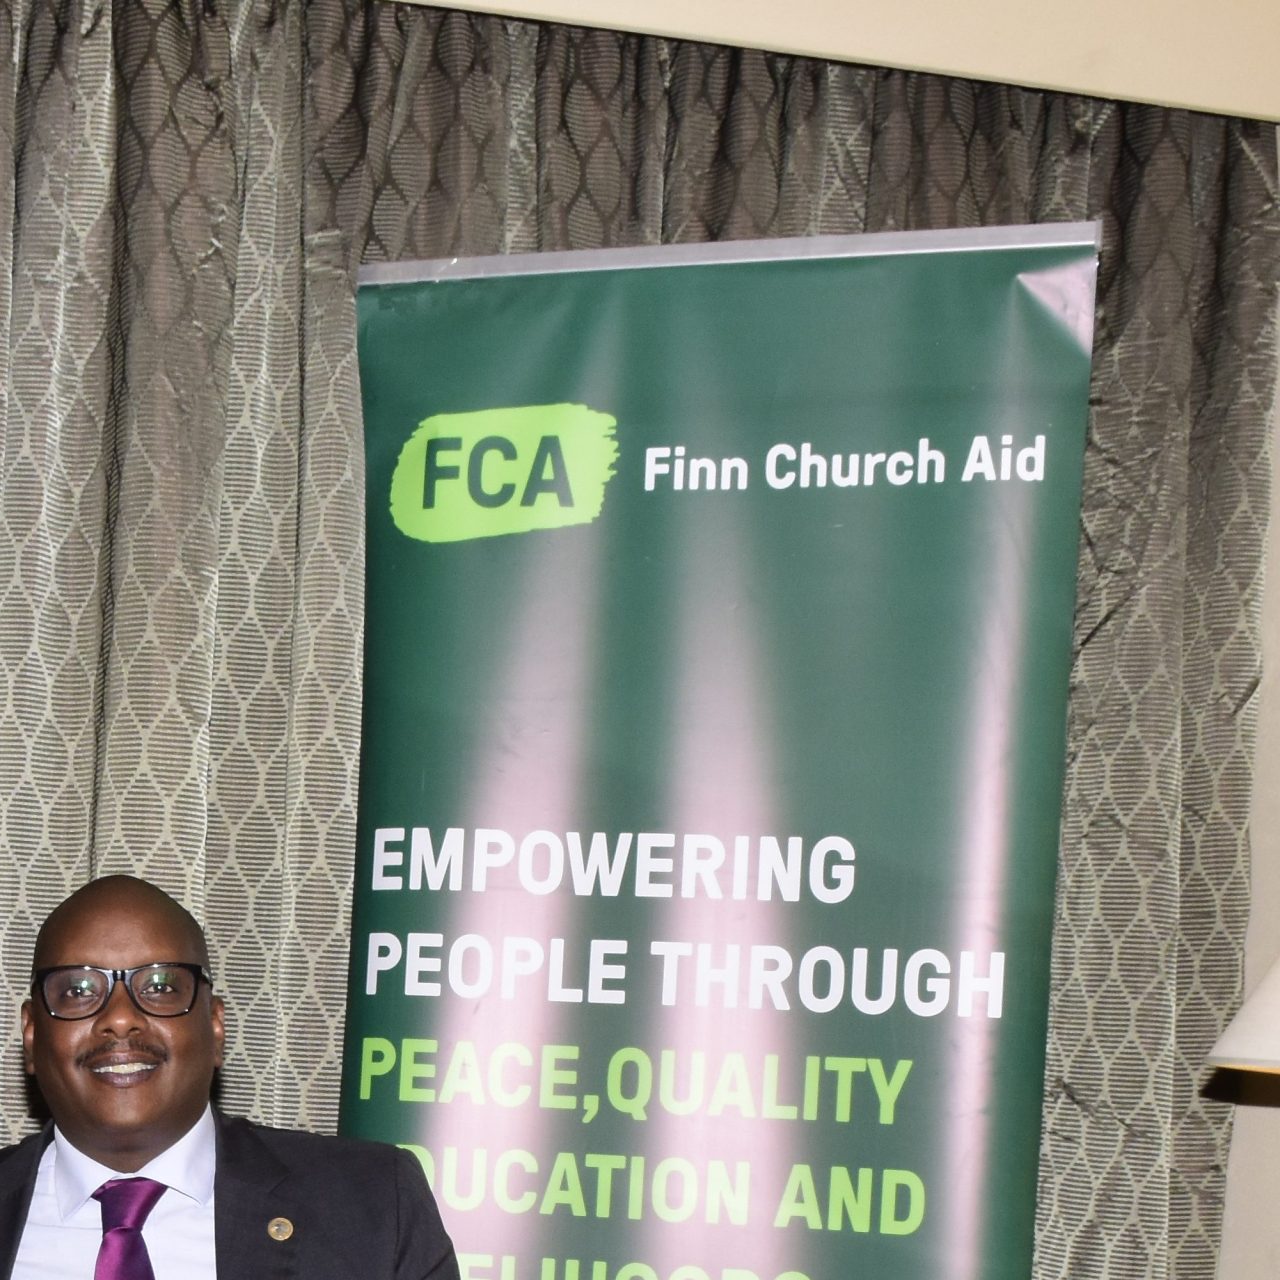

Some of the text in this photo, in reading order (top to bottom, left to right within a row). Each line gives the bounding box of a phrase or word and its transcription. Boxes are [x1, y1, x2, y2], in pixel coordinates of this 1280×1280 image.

[422, 433, 1047, 511] FCA Finn Church Aid
[370, 826, 857, 904] EMPOWERING
[364, 931, 1006, 1019] PEOPLE THROUGH
[358, 1036, 913, 1125] PEACE,QUALITY
[396, 1144, 927, 1237] UCATION AND
